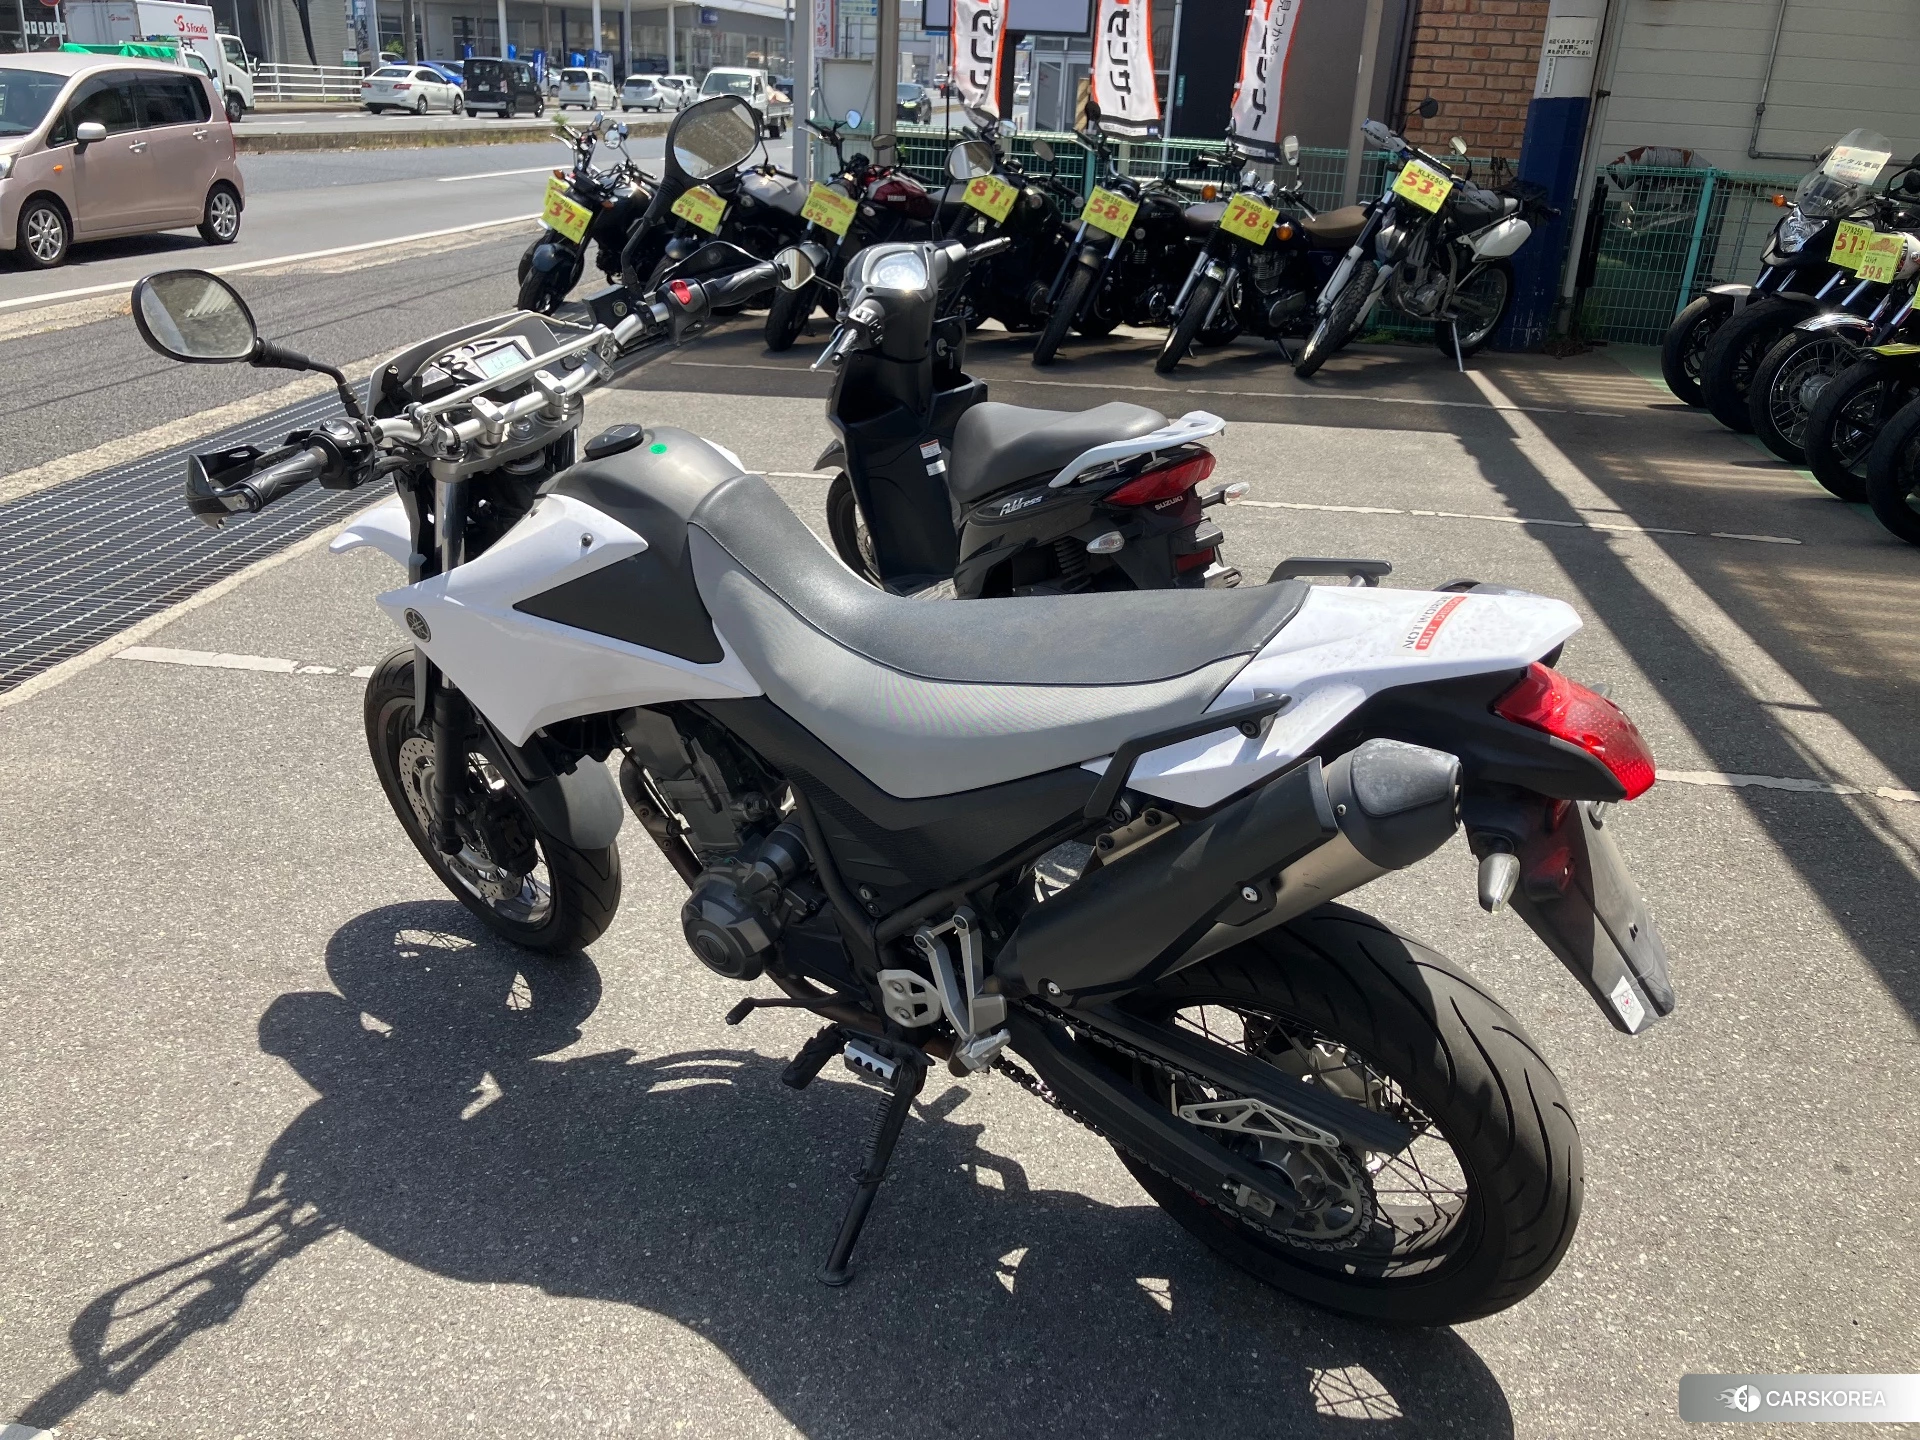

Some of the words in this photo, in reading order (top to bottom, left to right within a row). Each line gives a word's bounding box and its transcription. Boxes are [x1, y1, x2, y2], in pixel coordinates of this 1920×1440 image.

[1417, 168, 1444, 186] KLX250
[1242, 200, 1263, 214] SR400
[1000, 495, 1043, 517] Address
[1155, 495, 1184, 510] SUZUKI
[1402, 625, 1423, 649] NOT
